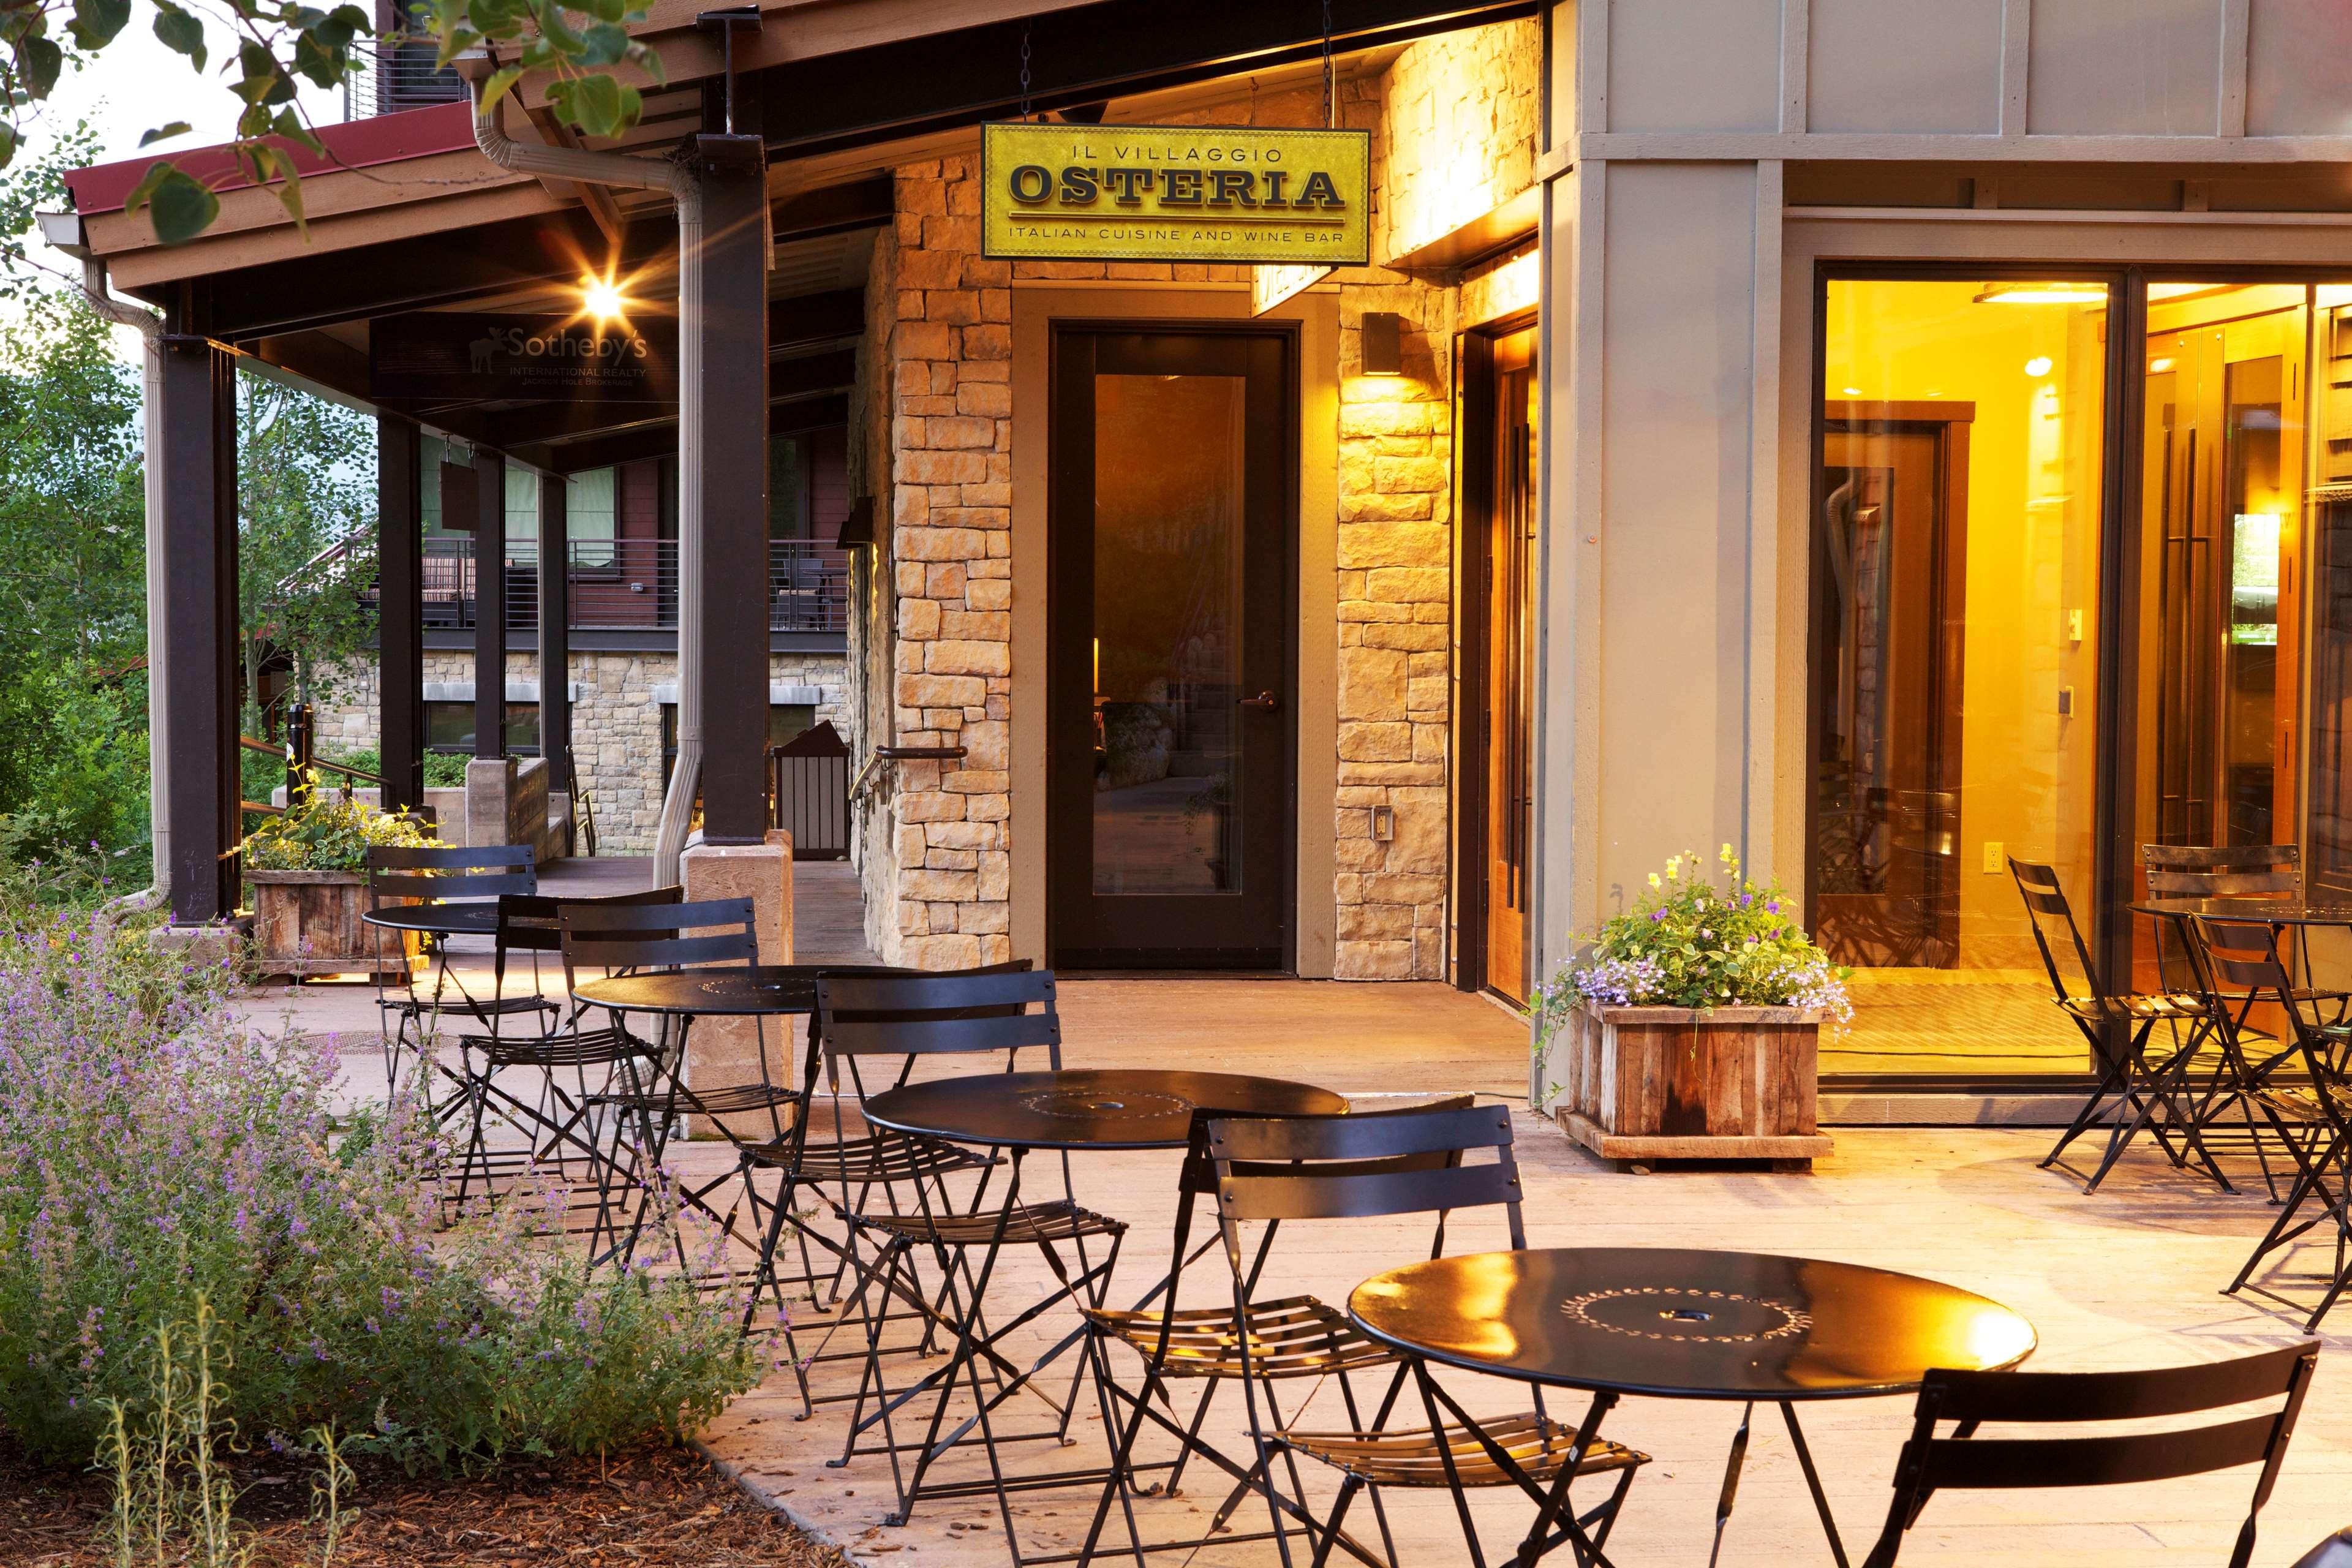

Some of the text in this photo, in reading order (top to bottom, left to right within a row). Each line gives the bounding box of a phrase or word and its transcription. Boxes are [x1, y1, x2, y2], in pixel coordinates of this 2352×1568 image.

[1073, 145, 1281, 162] IL VILLAGGIO
[1009, 165, 1346, 208] OSTERIA
[1009, 227, 1343, 243] ITALIAN CUISINE AND WINE BAR
[508, 328, 647, 366] Sotheby's
[510, 367, 647, 377] INTERNATIONAL REALTY
